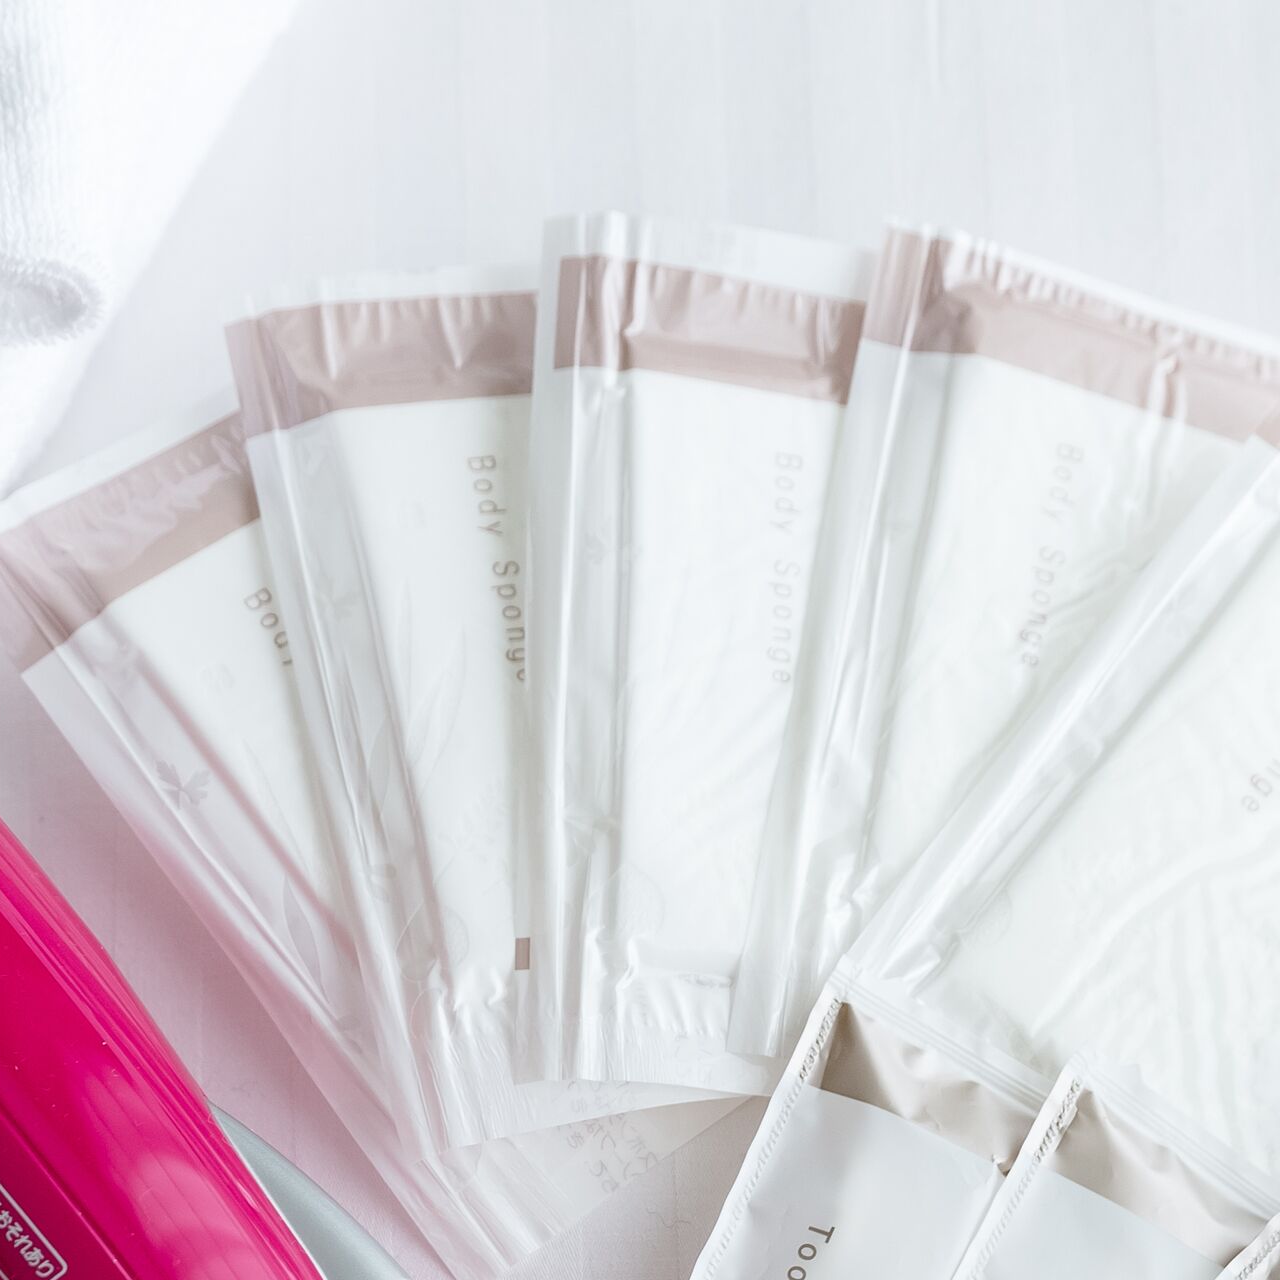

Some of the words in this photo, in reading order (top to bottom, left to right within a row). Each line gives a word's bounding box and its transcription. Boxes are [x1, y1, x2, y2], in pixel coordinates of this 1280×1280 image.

[467, 454, 507, 537] Body
[769, 452, 803, 535] Body
[1041, 442, 1084, 524] Body
[243, 586, 293, 668] Bod
[766, 560, 800, 685] Sponge
[1018, 545, 1066, 667] Sponge
